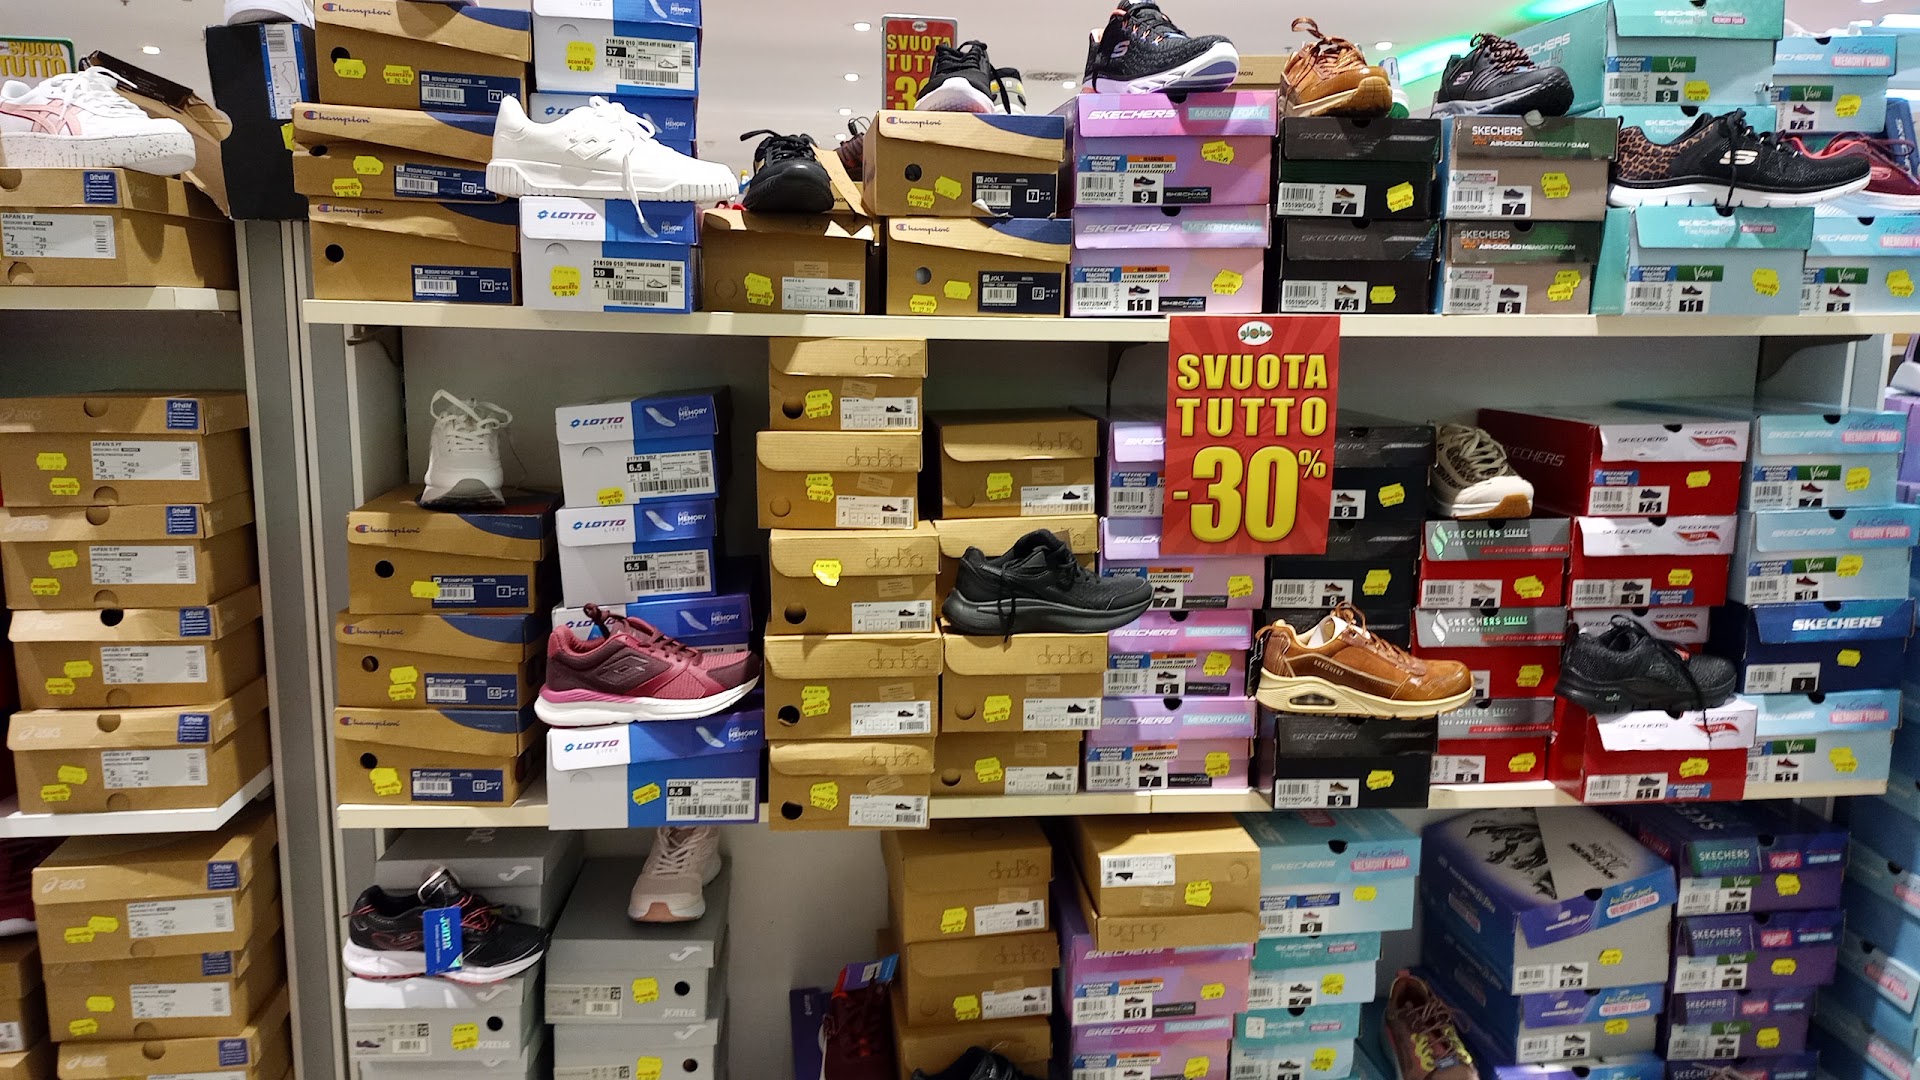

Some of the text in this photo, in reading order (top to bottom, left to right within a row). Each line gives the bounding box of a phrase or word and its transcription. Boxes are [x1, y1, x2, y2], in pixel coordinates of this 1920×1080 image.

[322, 2, 392, 17] Champion
[671, 6, 692, 14] MEMORY
[9, 41, 63, 58] SVUOTA
[0, 55, 66, 78] TUTTO
[1833, 57, 1888, 67] MEMORY FOAM
[490, 92, 500, 101] 7Y
[1663, 91, 1670, 102] 9
[303, 110, 371, 125] Champion
[1087, 109, 1264, 120] SKECHERS MEMORY FOAM
[886, 117, 942, 128] Champion
[1472, 126, 1524, 136] SKECHERS
[1140, 191, 1149, 203] 9
[317, 203, 384, 217] Champion
[1340, 203, 1348, 214] 7
[1509, 203, 1518, 215] 7
[550, 211, 597, 220] LOTTO
[896, 223, 950, 234] Champion
[1083, 223, 1172, 233] SKECHERS
[1188, 223, 1225, 232] MEMORY
[1460, 230, 1511, 240] SKECHERS
[594, 269, 605, 277] 39
[482, 283, 492, 291] 7Y
[1130, 300, 1146, 311] 11
[1338, 299, 1355, 310] 7.5
[1504, 302, 1513, 313] 6
[1683, 300, 1697, 312] 11
[1176, 353, 1328, 390] SVUOTA
[679, 408, 707, 416] MEMORY
[1175, 396, 1328, 437] TUTTO
[582, 416, 624, 426] LOTTO
[846, 446, 903, 468] diadora
[628, 463, 643, 472] 6.5
[1172, 445, 1326, 543] -30%
[1341, 507, 1349, 517] 8
[678, 514, 706, 522] MEMORY
[585, 519, 626, 529] LOTTO
[355, 524, 421, 537] Champion
[1447, 529, 1501, 538] SKECHERS
[625, 562, 640, 571] 6.5
[1161, 598, 1169, 608] 7
[1329, 596, 1336, 607] 8
[711, 614, 740, 622] MEMORY
[1447, 617, 1501, 626] SKECHERS
[1791, 615, 1884, 631] SKECHERS
[343, 625, 404, 639] Champion
[1112, 628, 1179, 637] SKECHERS
[1313, 659, 1345, 676] SKECHERS
[1163, 683, 1171, 694] 6
[339, 716, 400, 729] Champion
[1102, 716, 1176, 725] SKECHERS
[728, 729, 758, 738] MEMORY
[576, 740, 619, 749] LOTTO
[1145, 776, 1154, 787] 7
[1699, 850, 1750, 862] SKECHERS
[1692, 928, 1742, 940] SKECHERS
[1686, 1000, 1727, 1010] SKECHERS
[1085, 1025, 1158, 1037] SKECHERS
